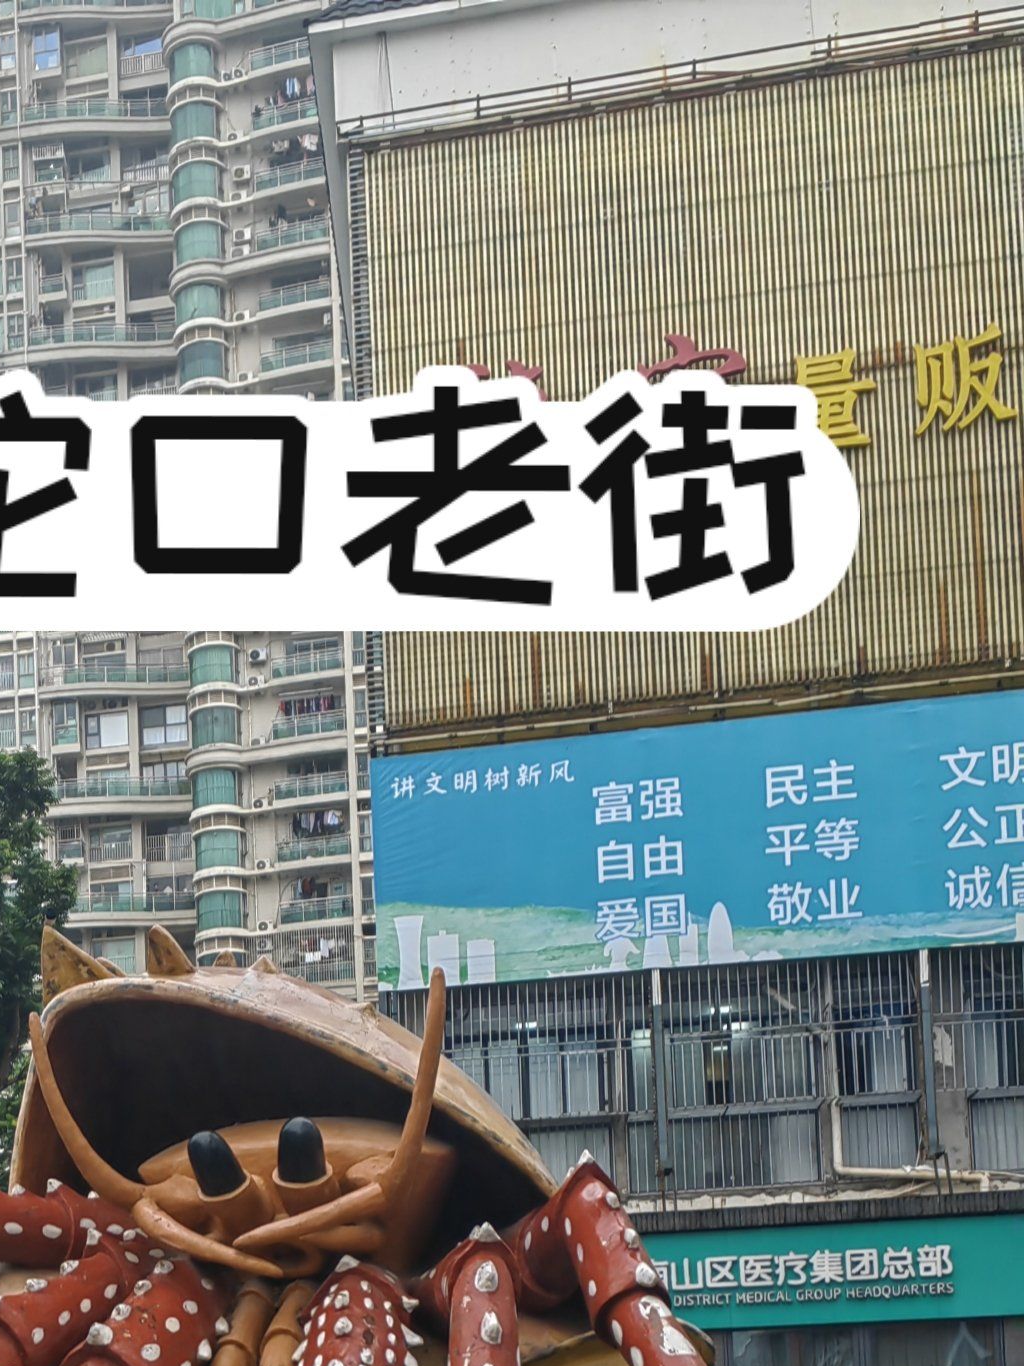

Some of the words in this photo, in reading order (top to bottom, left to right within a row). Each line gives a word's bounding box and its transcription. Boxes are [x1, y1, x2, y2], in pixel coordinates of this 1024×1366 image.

[390, 759, 575, 799] 讲文明树新风
[765, 759, 858, 809] 民主
[939, 742, 1024, 791] 文明
[592, 776, 684, 825] 富强
[765, 817, 860, 866] 平等
[943, 803, 1024, 849] 公正
[597, 835, 684, 883] 自由
[767, 878, 863, 926] 敬业
[944, 862, 1024, 911] 诚信
[594, 893, 688, 941] 爱国
[674, 1293, 731, 1307] DISTRICT
[735, 1290, 791, 1304] MEDICAL
[795, 1287, 841, 1302] GROUP
[845, 1282, 954, 1299] HEADQUARTERS
